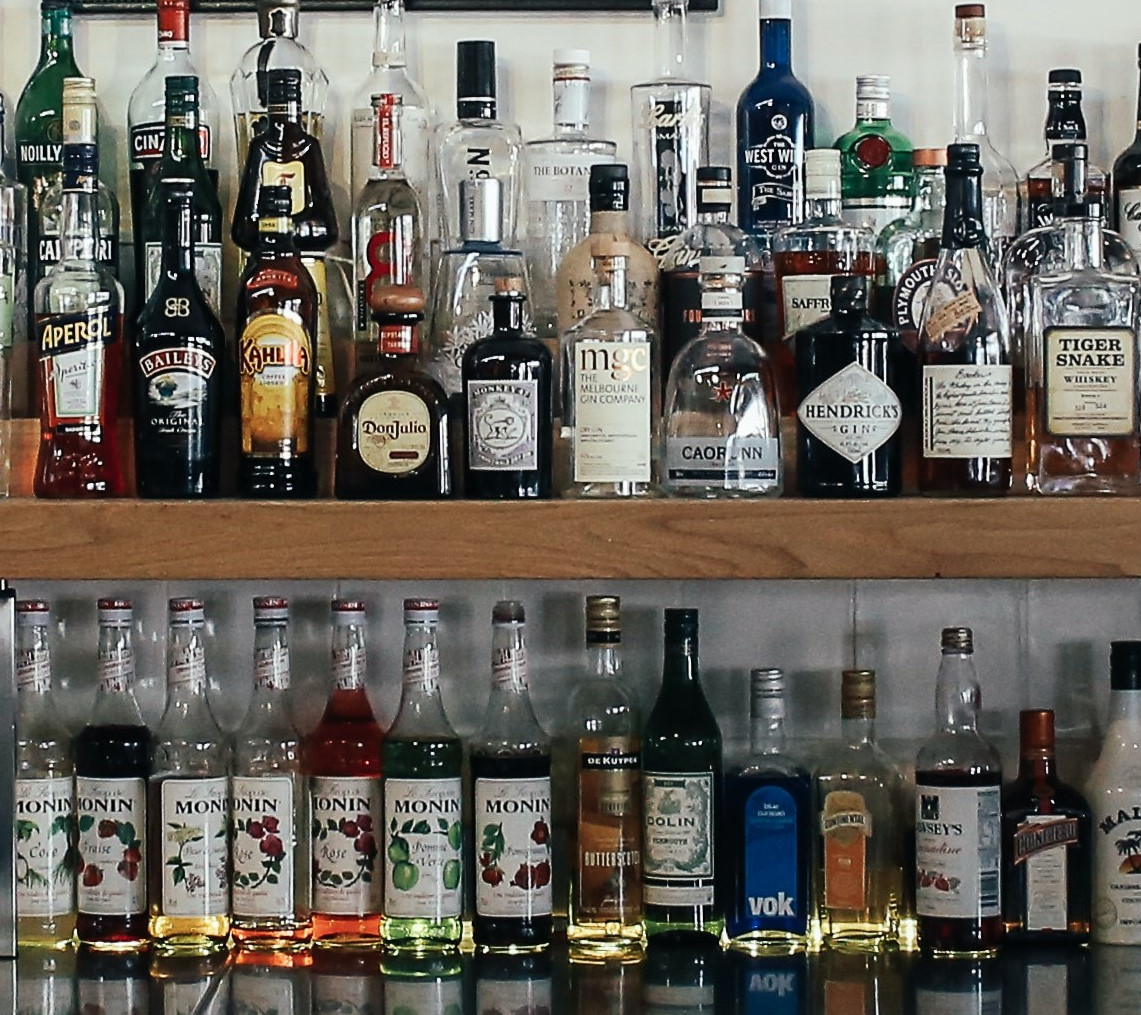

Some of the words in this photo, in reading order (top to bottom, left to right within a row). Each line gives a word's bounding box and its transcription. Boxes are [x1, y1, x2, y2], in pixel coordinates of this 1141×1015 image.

[20, 143, 62, 163] NOILLY
[744, 148, 775, 164] WEST
[42, 315, 112, 352] APEROL
[1058, 338, 1122, 352] TIGER
[144, 350, 215, 373] BAILEYS
[580, 348, 646, 382] mgc
[1056, 353, 1125, 367] SNAKE
[580, 373, 598, 383] THE
[1063, 375, 1118, 384] WHISKEY
[580, 384, 638, 394] MELBOURNE
[599, 395, 645, 404] COMPANY
[805, 404, 899, 419] HENDRICK'S
[839, 425, 871, 435] GIN
[394, 798, 461, 814] MONIN
[485, 798, 550, 814] MONIN
[646, 816, 695, 827] DOLIN
[748, 891, 796, 918] vok
